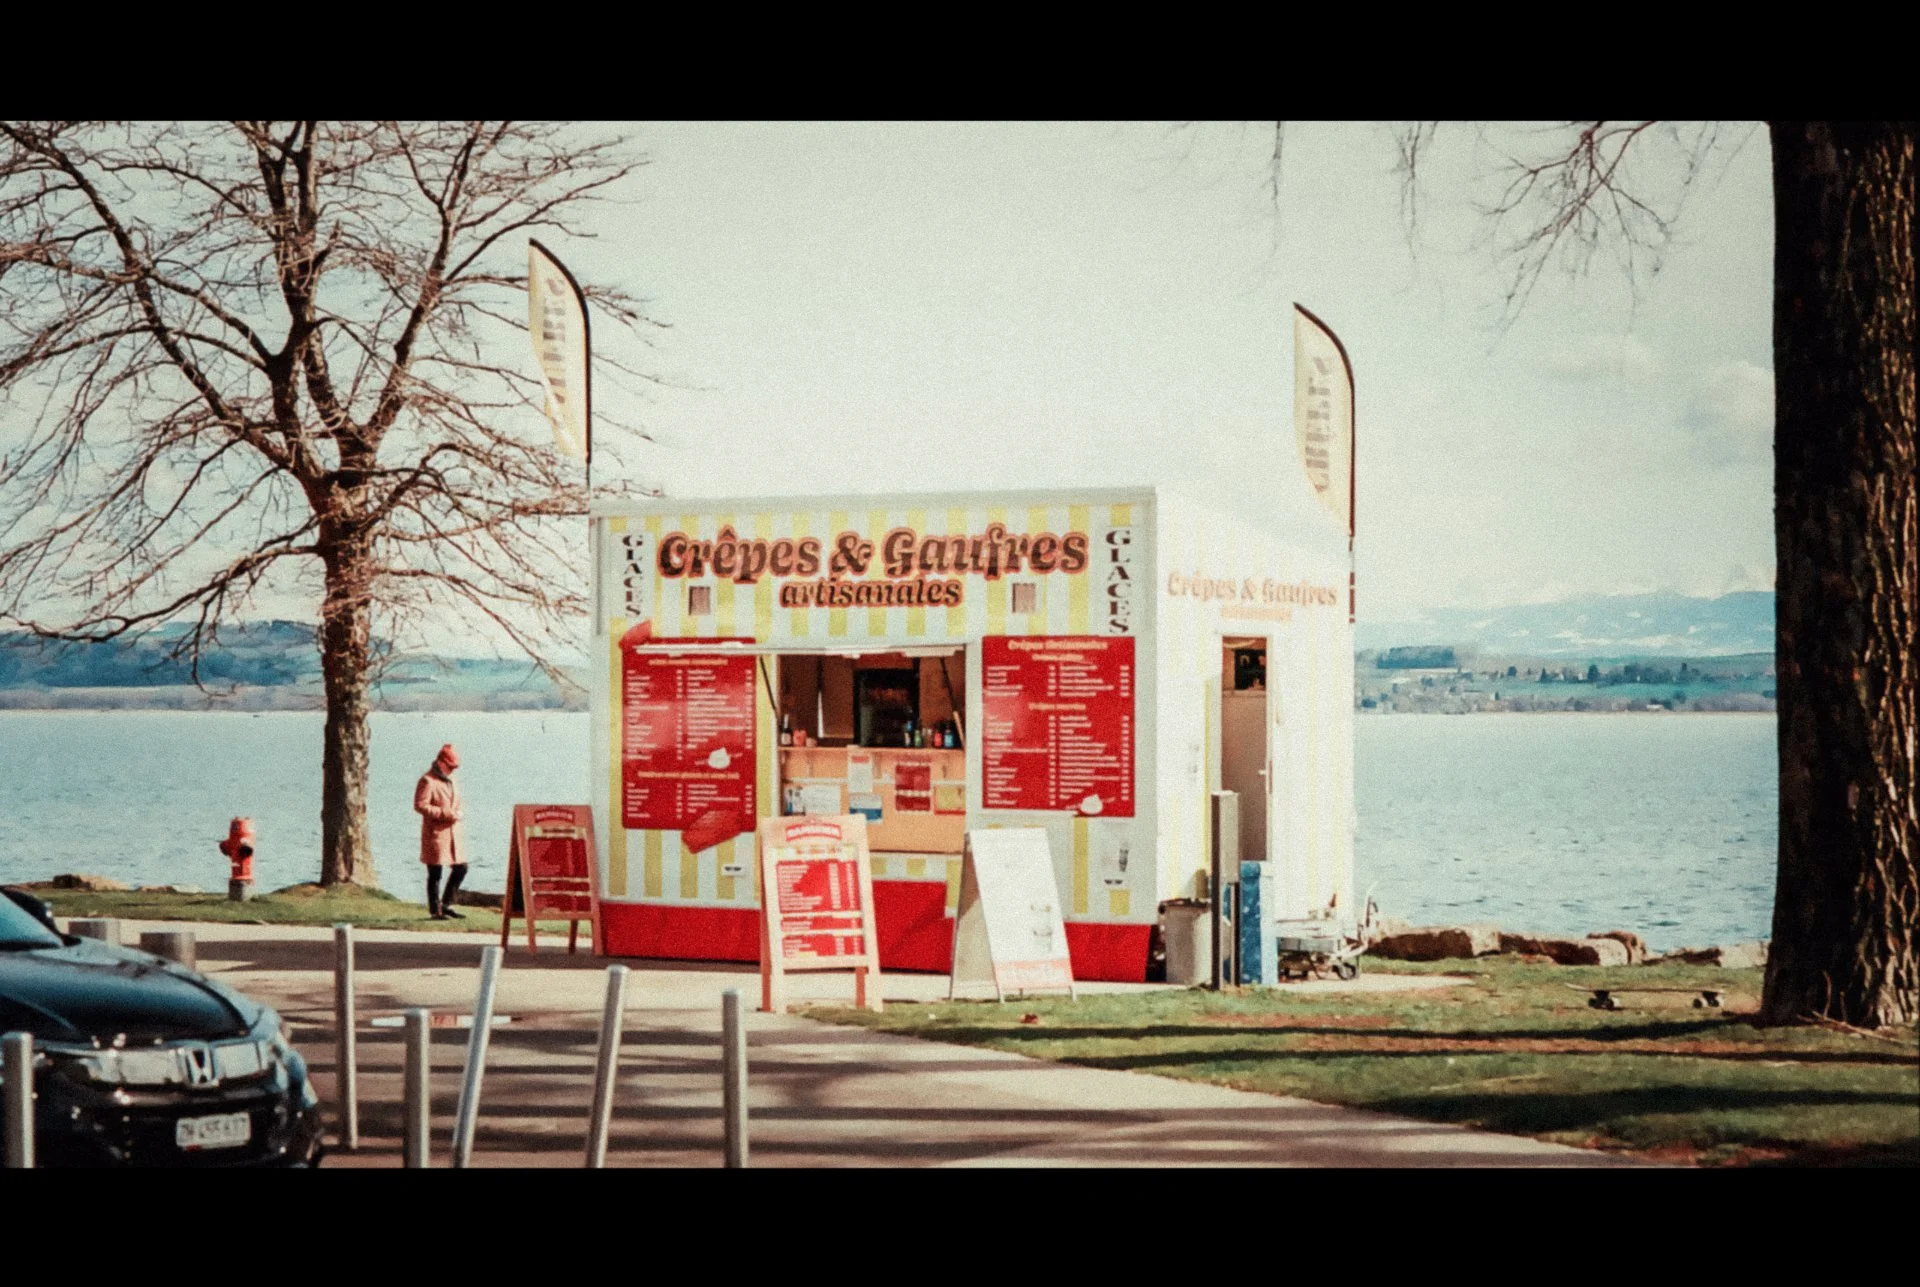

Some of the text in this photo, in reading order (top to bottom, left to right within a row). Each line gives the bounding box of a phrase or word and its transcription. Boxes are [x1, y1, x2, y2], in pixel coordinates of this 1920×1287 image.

[658, 522, 1090, 583] Crêpes & Gaufres
[1105, 530, 1131, 633] GLACES
[780, 578, 963, 607] artisanales
